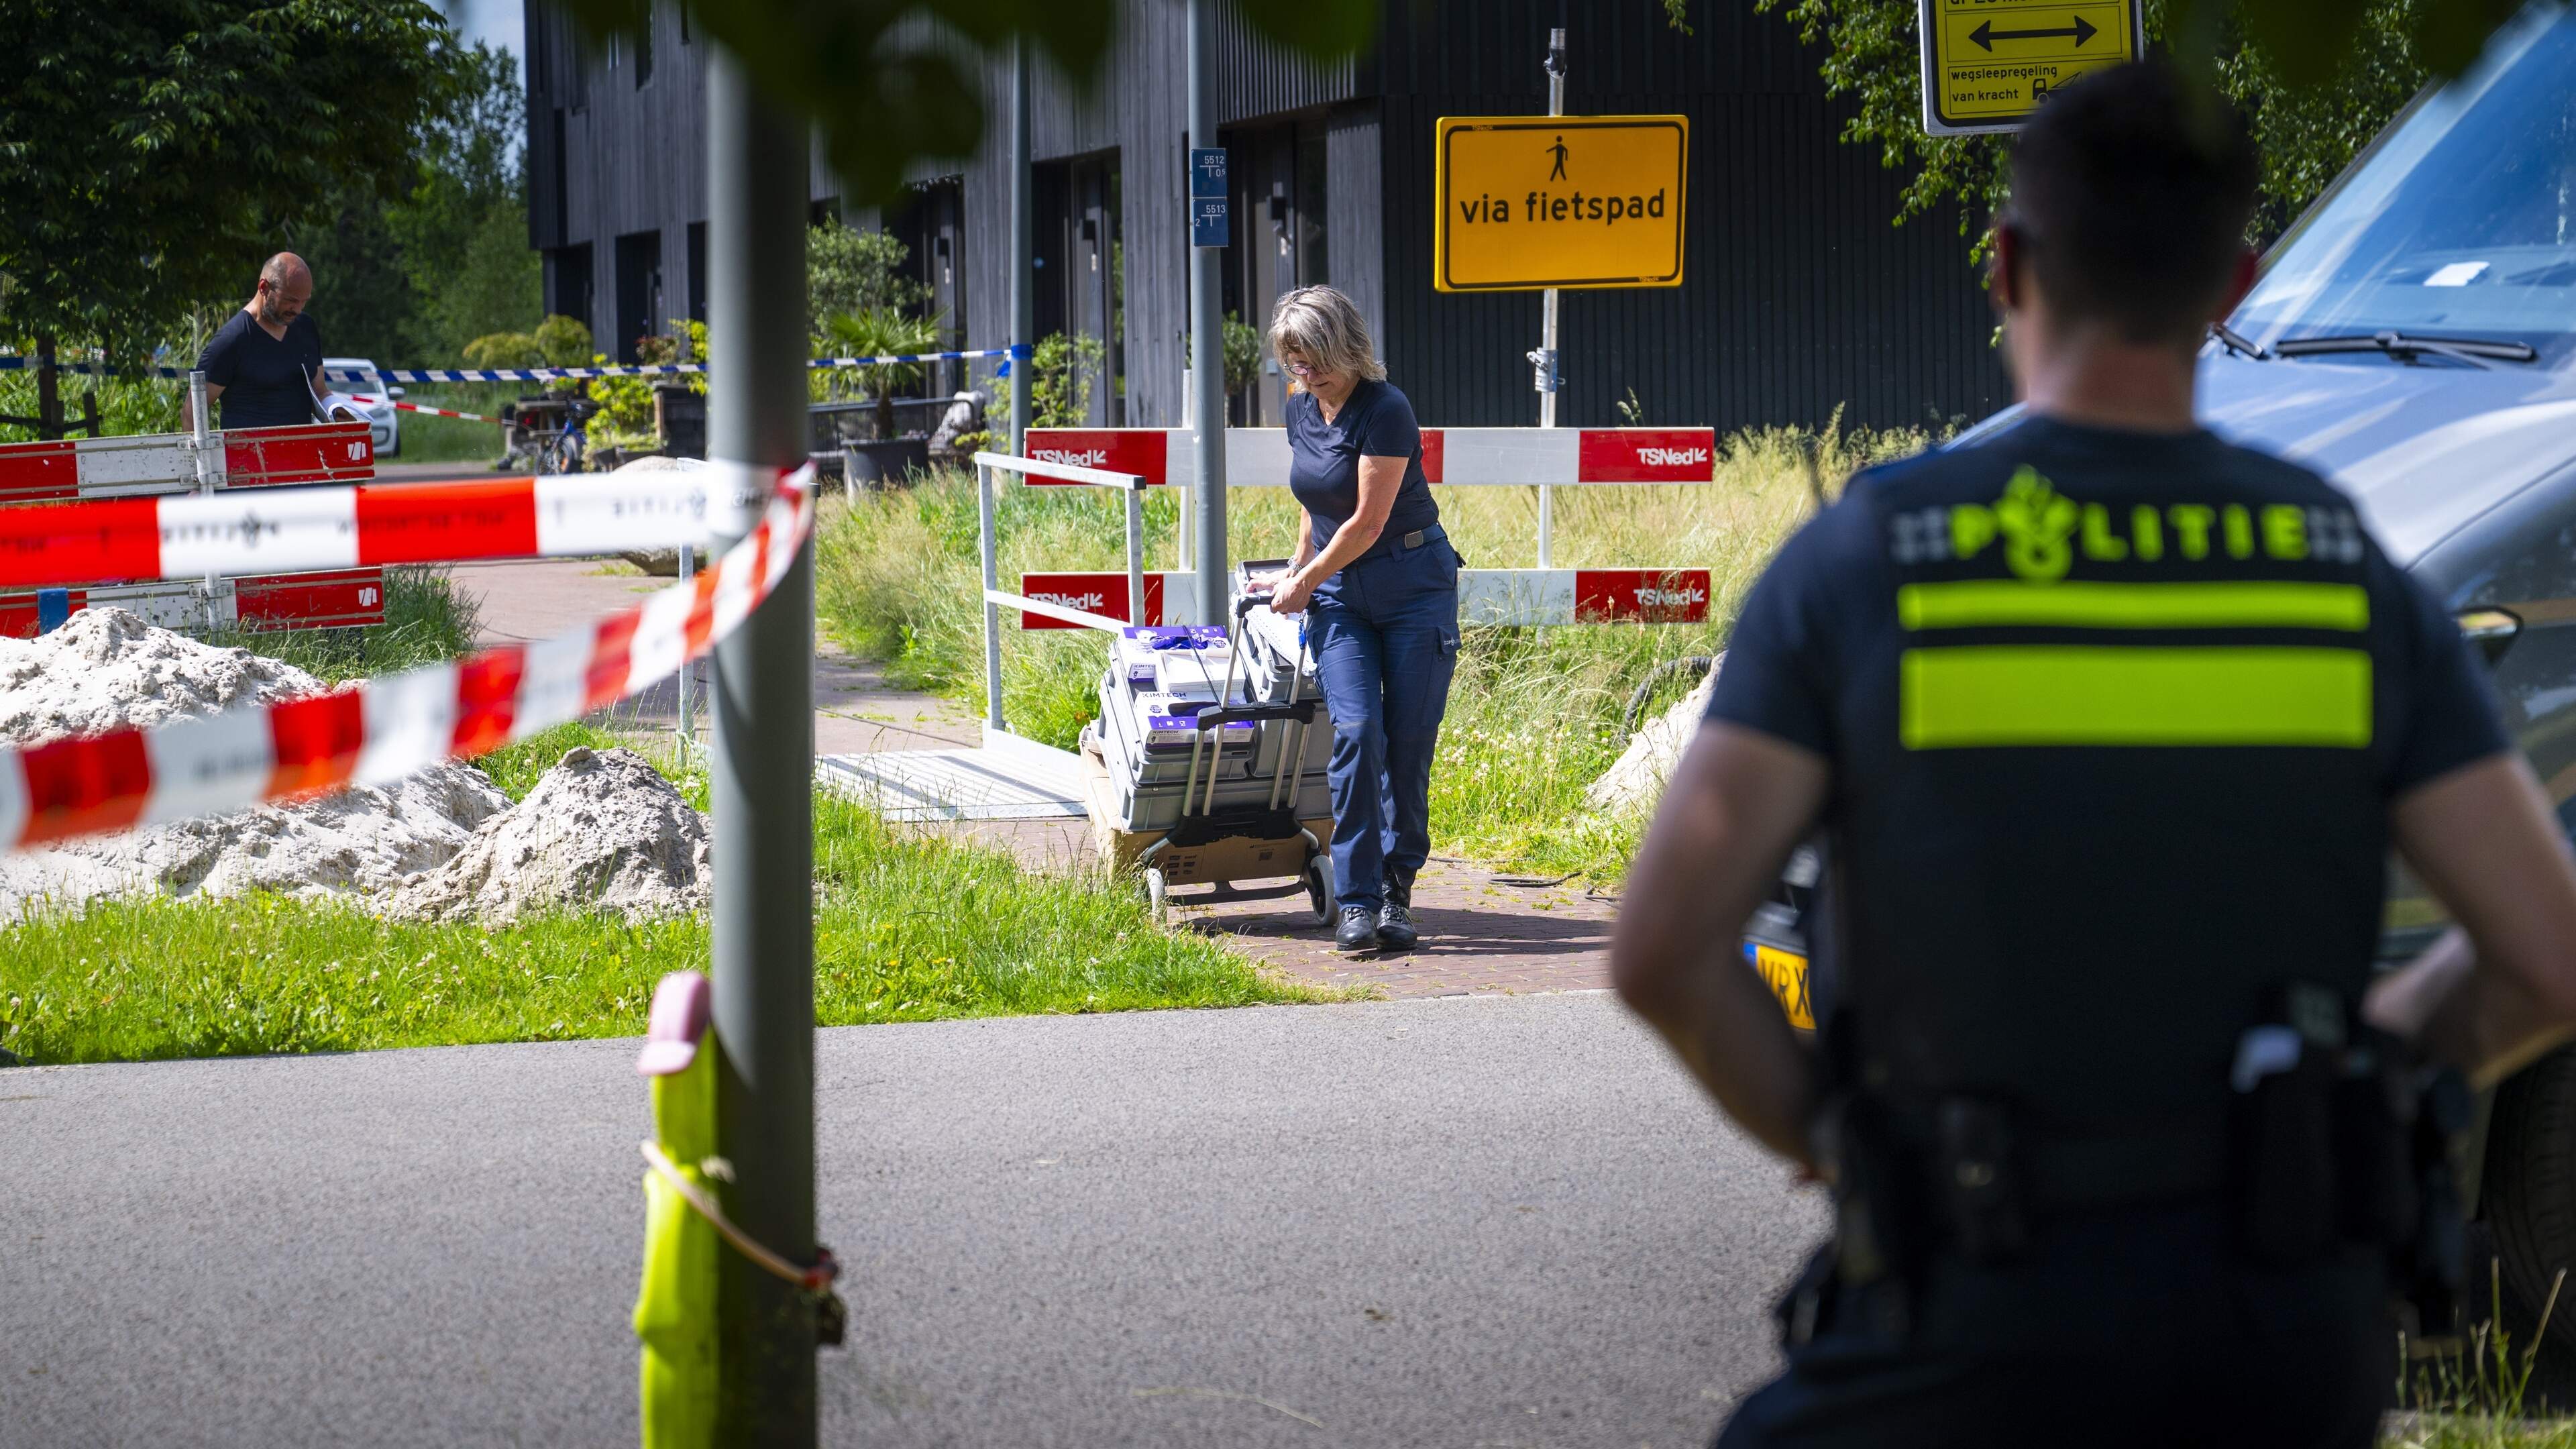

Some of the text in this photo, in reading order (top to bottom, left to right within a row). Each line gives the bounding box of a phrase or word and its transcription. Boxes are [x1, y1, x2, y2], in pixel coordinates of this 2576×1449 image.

[1951, 66, 2057, 82] wegsleepregeling
[1952, 89, 2019, 101] van kracht
[1204, 155, 1224, 164] 5512
[1460, 188, 1665, 225] via fietspad
[1195, 218, 1201, 227] 2
[1636, 447, 1693, 466] TSNed
[1633, 588, 1690, 606] TSNed
